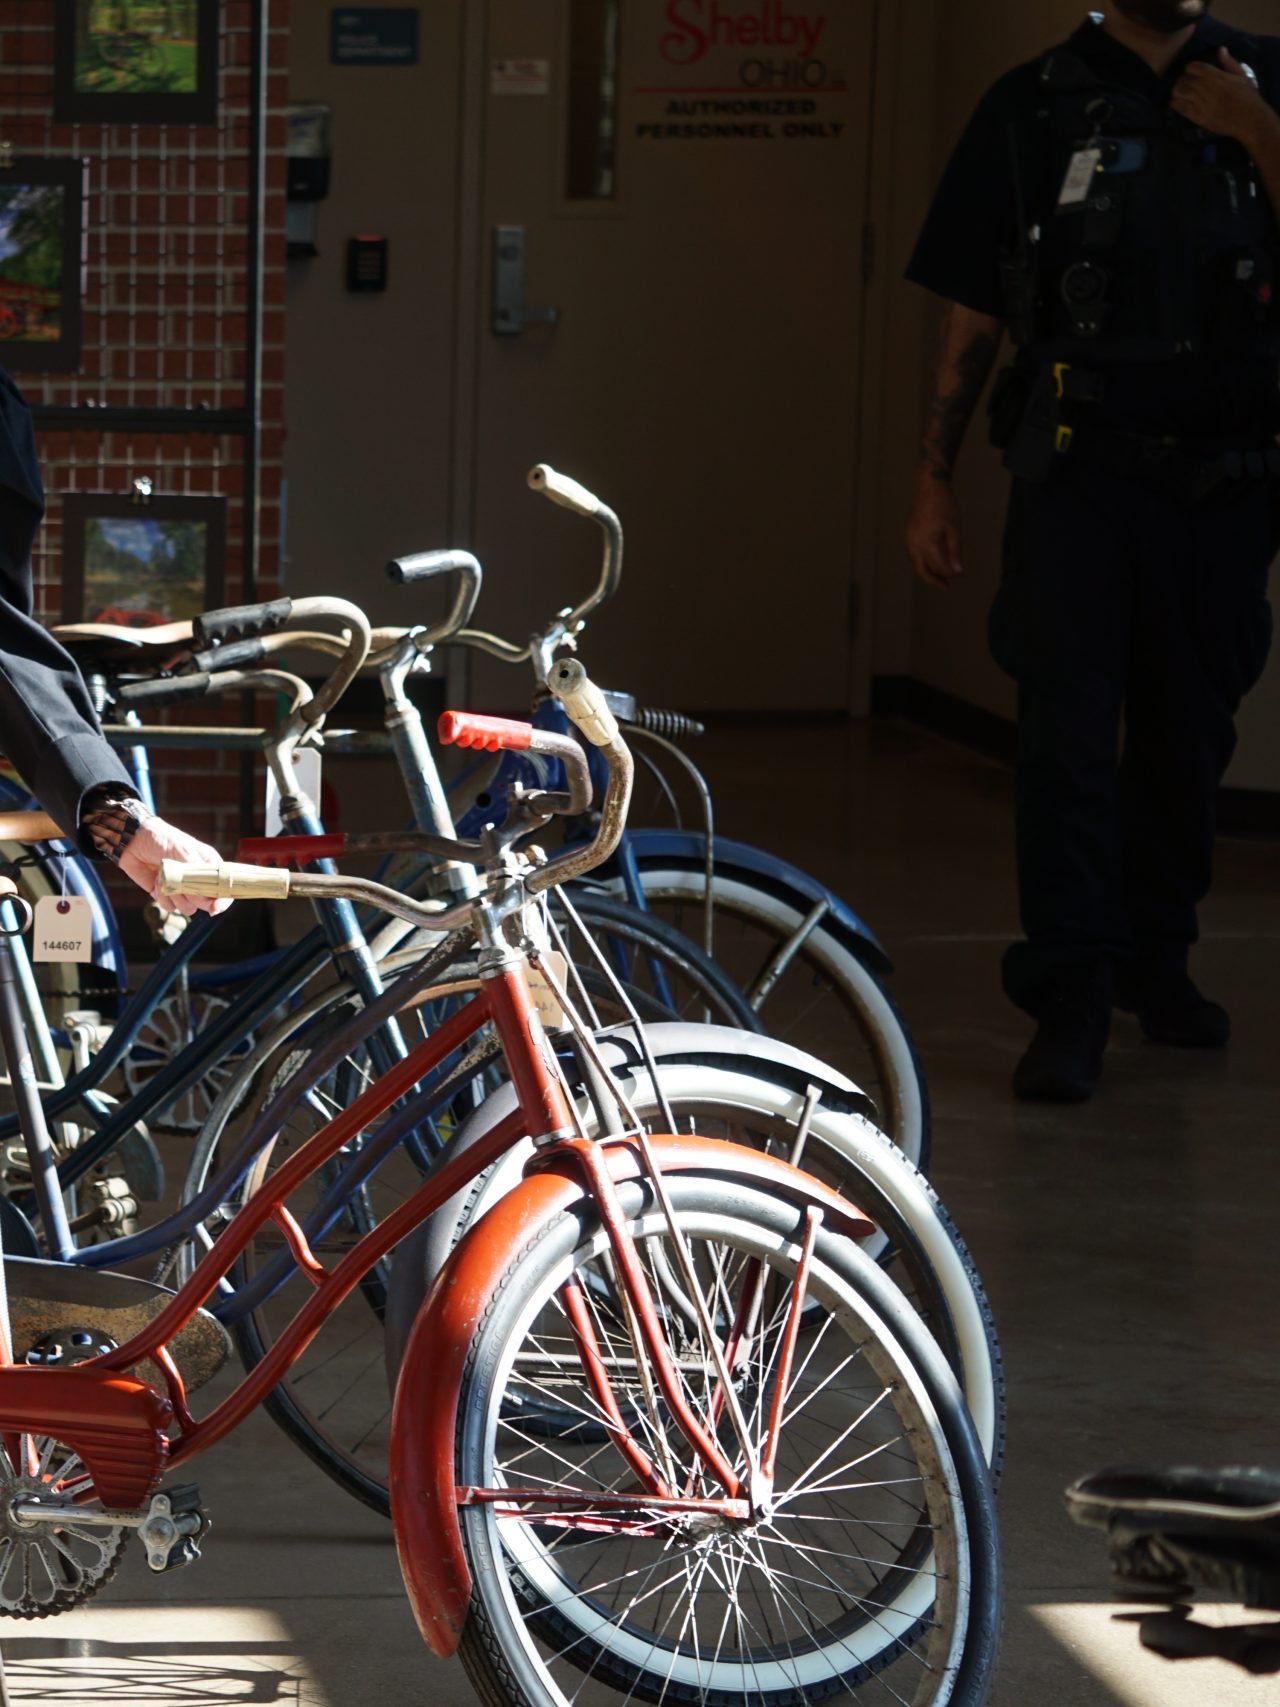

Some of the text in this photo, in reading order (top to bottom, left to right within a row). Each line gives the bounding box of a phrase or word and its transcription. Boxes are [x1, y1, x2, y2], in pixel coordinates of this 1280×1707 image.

[659, 0, 827, 65] Shelby
[738, 57, 827, 89] OHIO
[665, 99, 816, 115] AUTHORIZED
[635, 122, 845, 139] PERSONNEL ONLY
[42, 941, 82, 951] 144607
